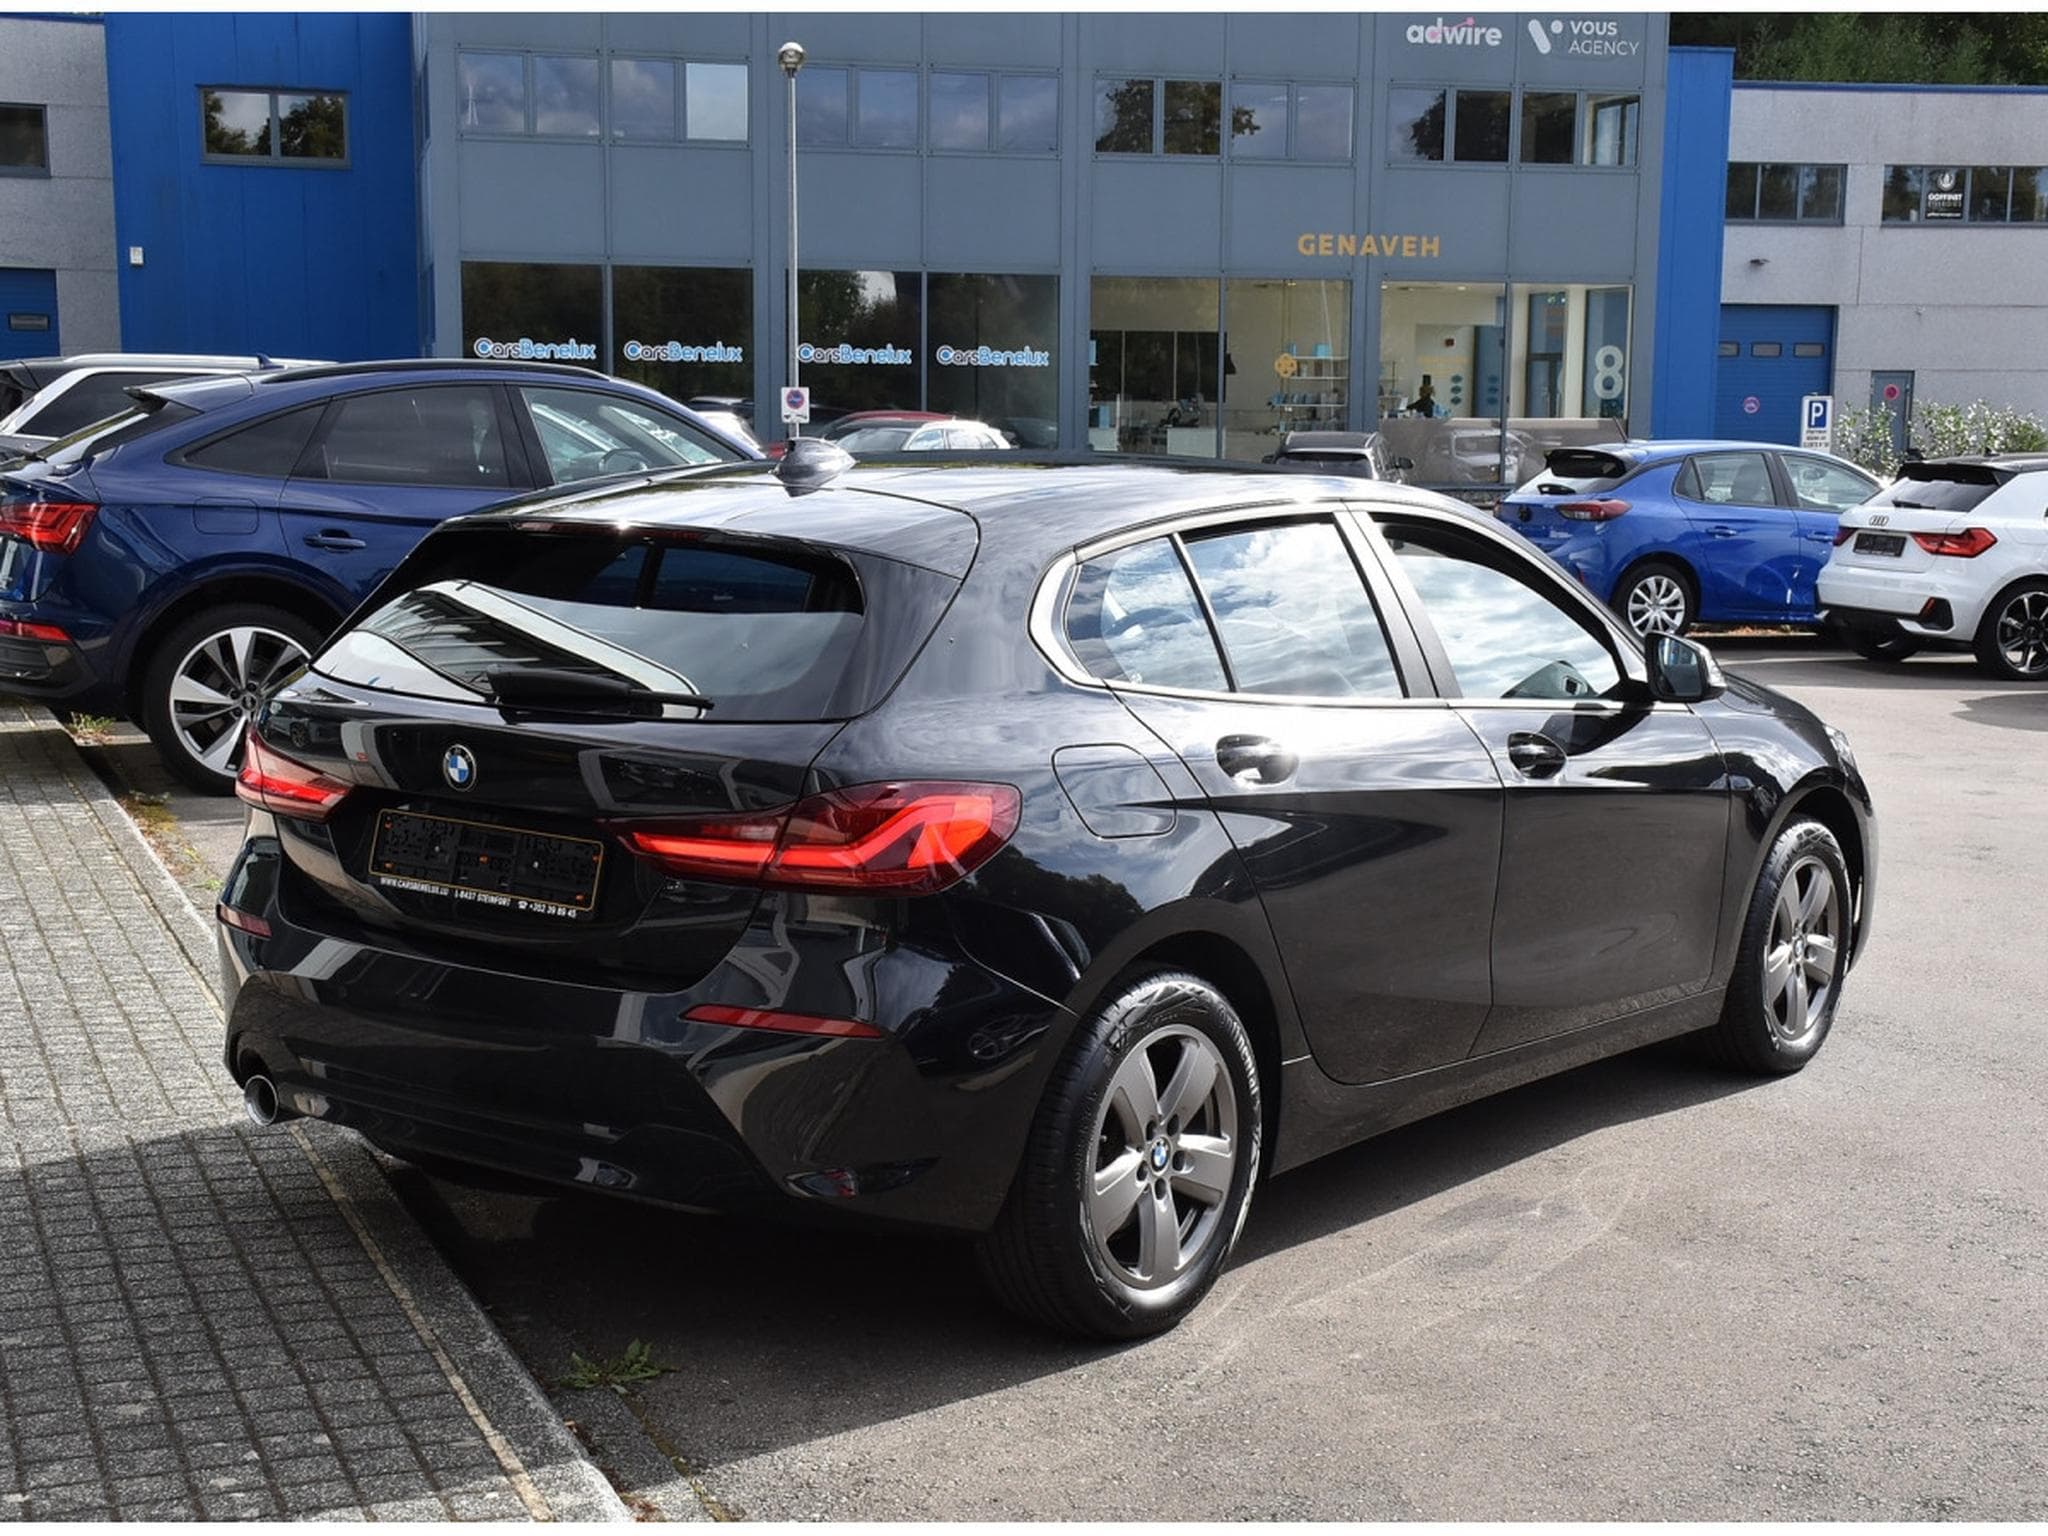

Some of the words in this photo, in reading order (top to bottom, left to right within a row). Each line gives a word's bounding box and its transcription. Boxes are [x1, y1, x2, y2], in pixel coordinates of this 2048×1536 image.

[1405, 17, 1502, 46] adwire
[1569, 20, 1618, 35] VOUS
[1568, 39, 1640, 56] AGENCY
[1297, 233, 1441, 257] GENAVEH
[473, 337, 597, 360] CarsBenelux
[623, 340, 743, 363] CarsBenelux
[797, 342, 912, 365] CarsBenelux
[936, 345, 1050, 367] CarsBenelux
[1593, 345, 1624, 400] 8
[1811, 402, 1824, 426] P
